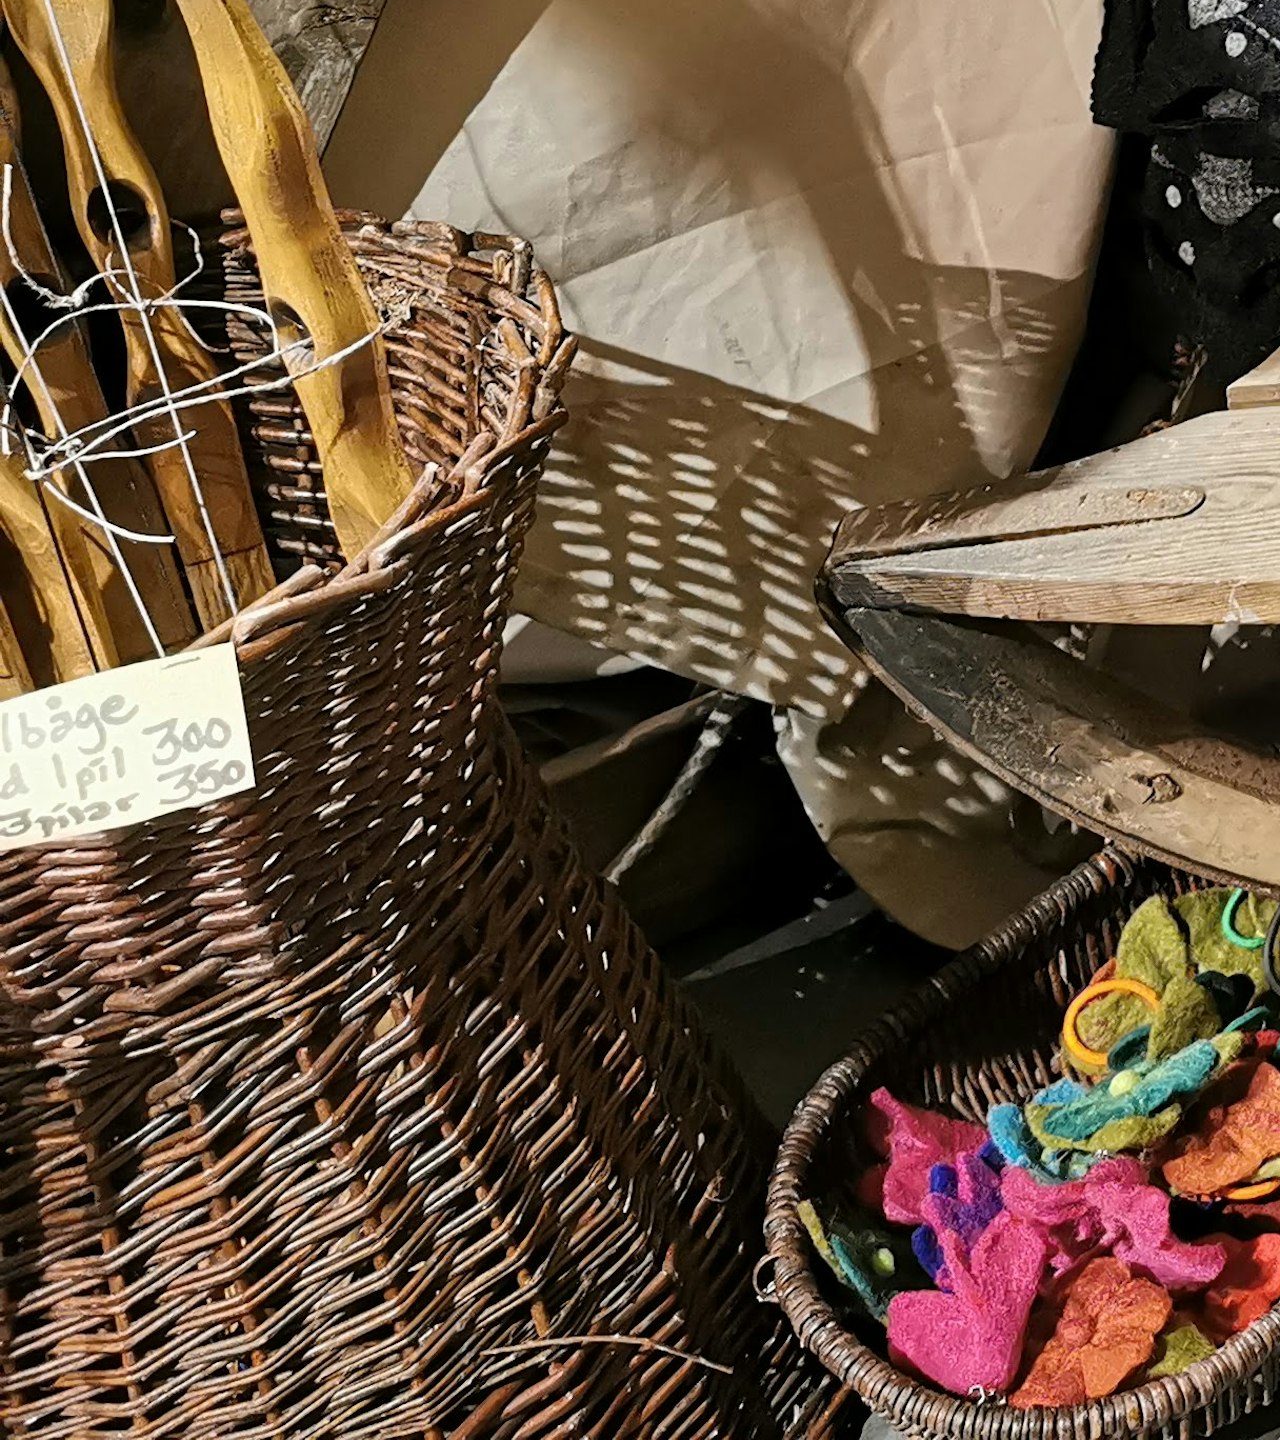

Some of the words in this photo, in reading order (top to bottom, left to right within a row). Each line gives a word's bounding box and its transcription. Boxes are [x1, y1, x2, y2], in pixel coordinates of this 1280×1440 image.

[76, 745, 126, 801] pil
[142, 717, 233, 766] 300
[157, 759, 246, 805] 350
